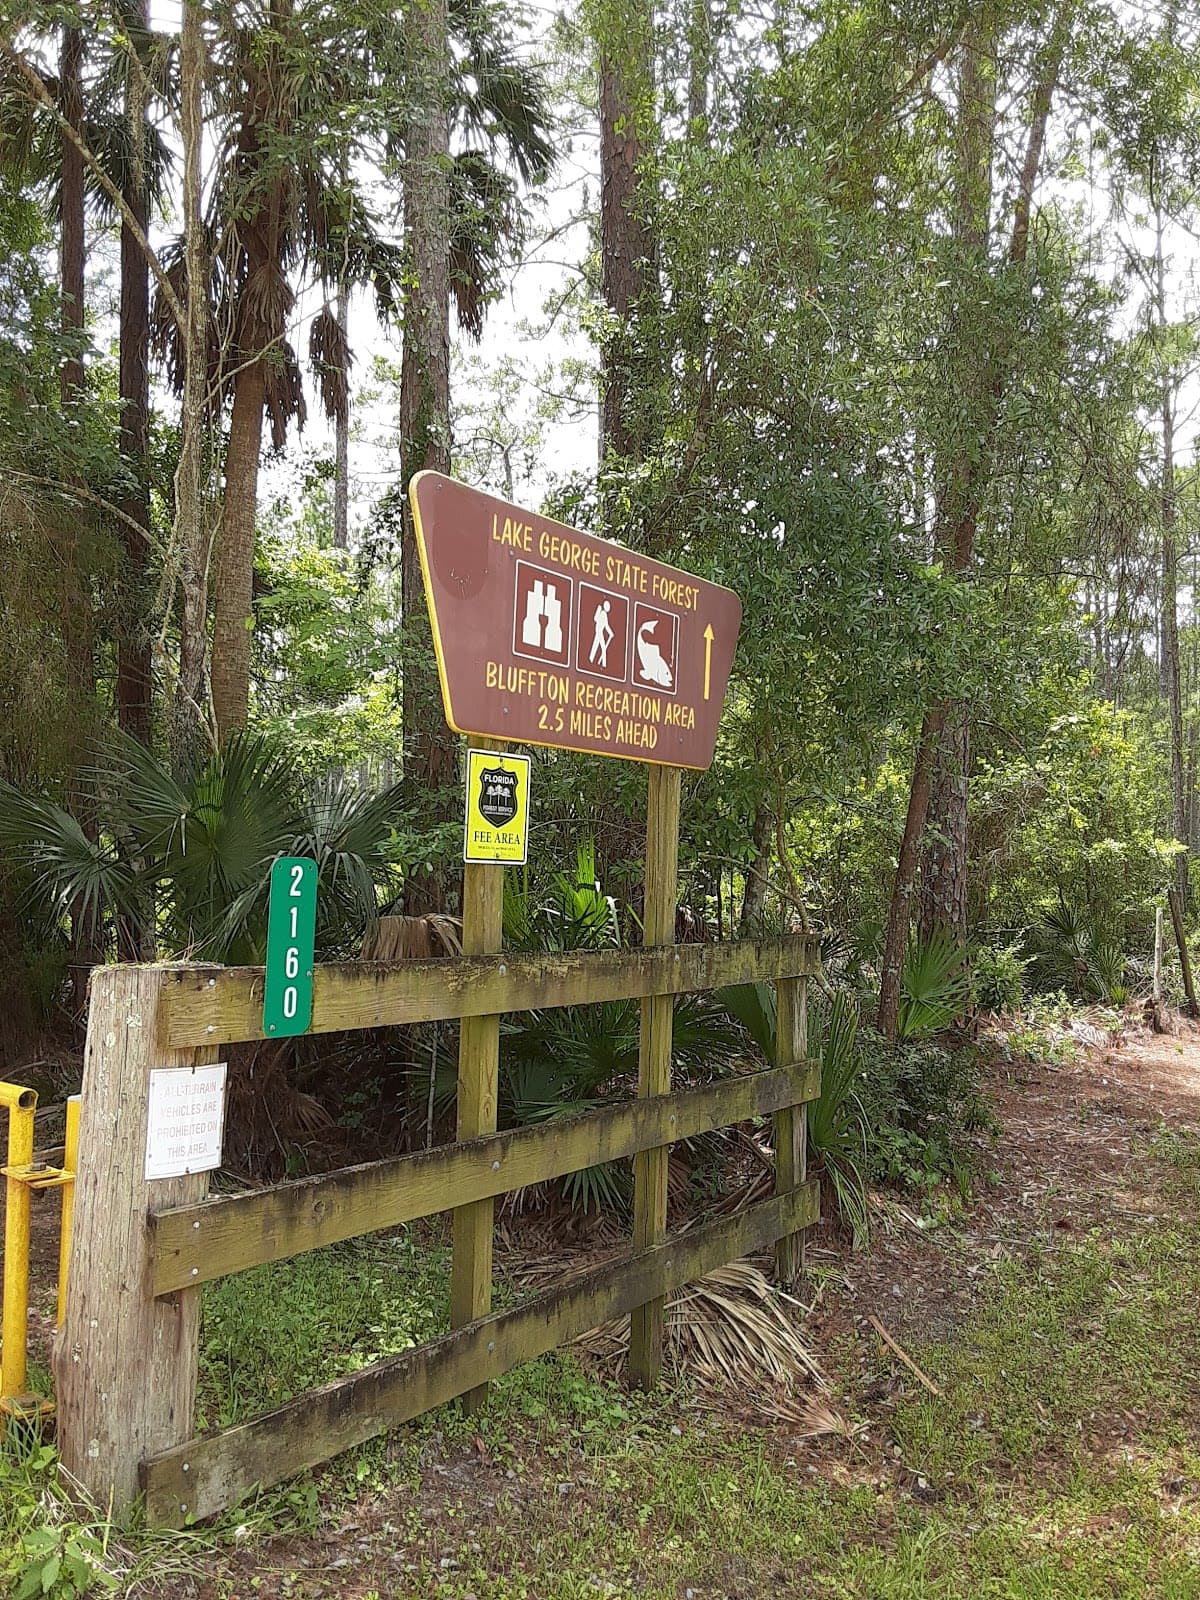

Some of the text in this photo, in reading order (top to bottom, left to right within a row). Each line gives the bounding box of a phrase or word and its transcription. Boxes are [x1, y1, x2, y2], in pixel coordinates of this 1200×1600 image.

[493, 513, 699, 611] LAKE GEORGE STATE FOREST
[486, 661, 695, 730] BLUFFTON RECREATION AREA
[538, 704, 658, 749] 2.5 MILES AHEAD
[484, 774, 514, 785] FLORIDA
[474, 831, 520, 845] FEE AREA
[283, 865, 304, 1018] 2160
[161, 1101, 217, 1118] VEHICLES ARE
[208, 1120, 218, 1132] ON
[168, 1142, 208, 1159] THIS AREA
